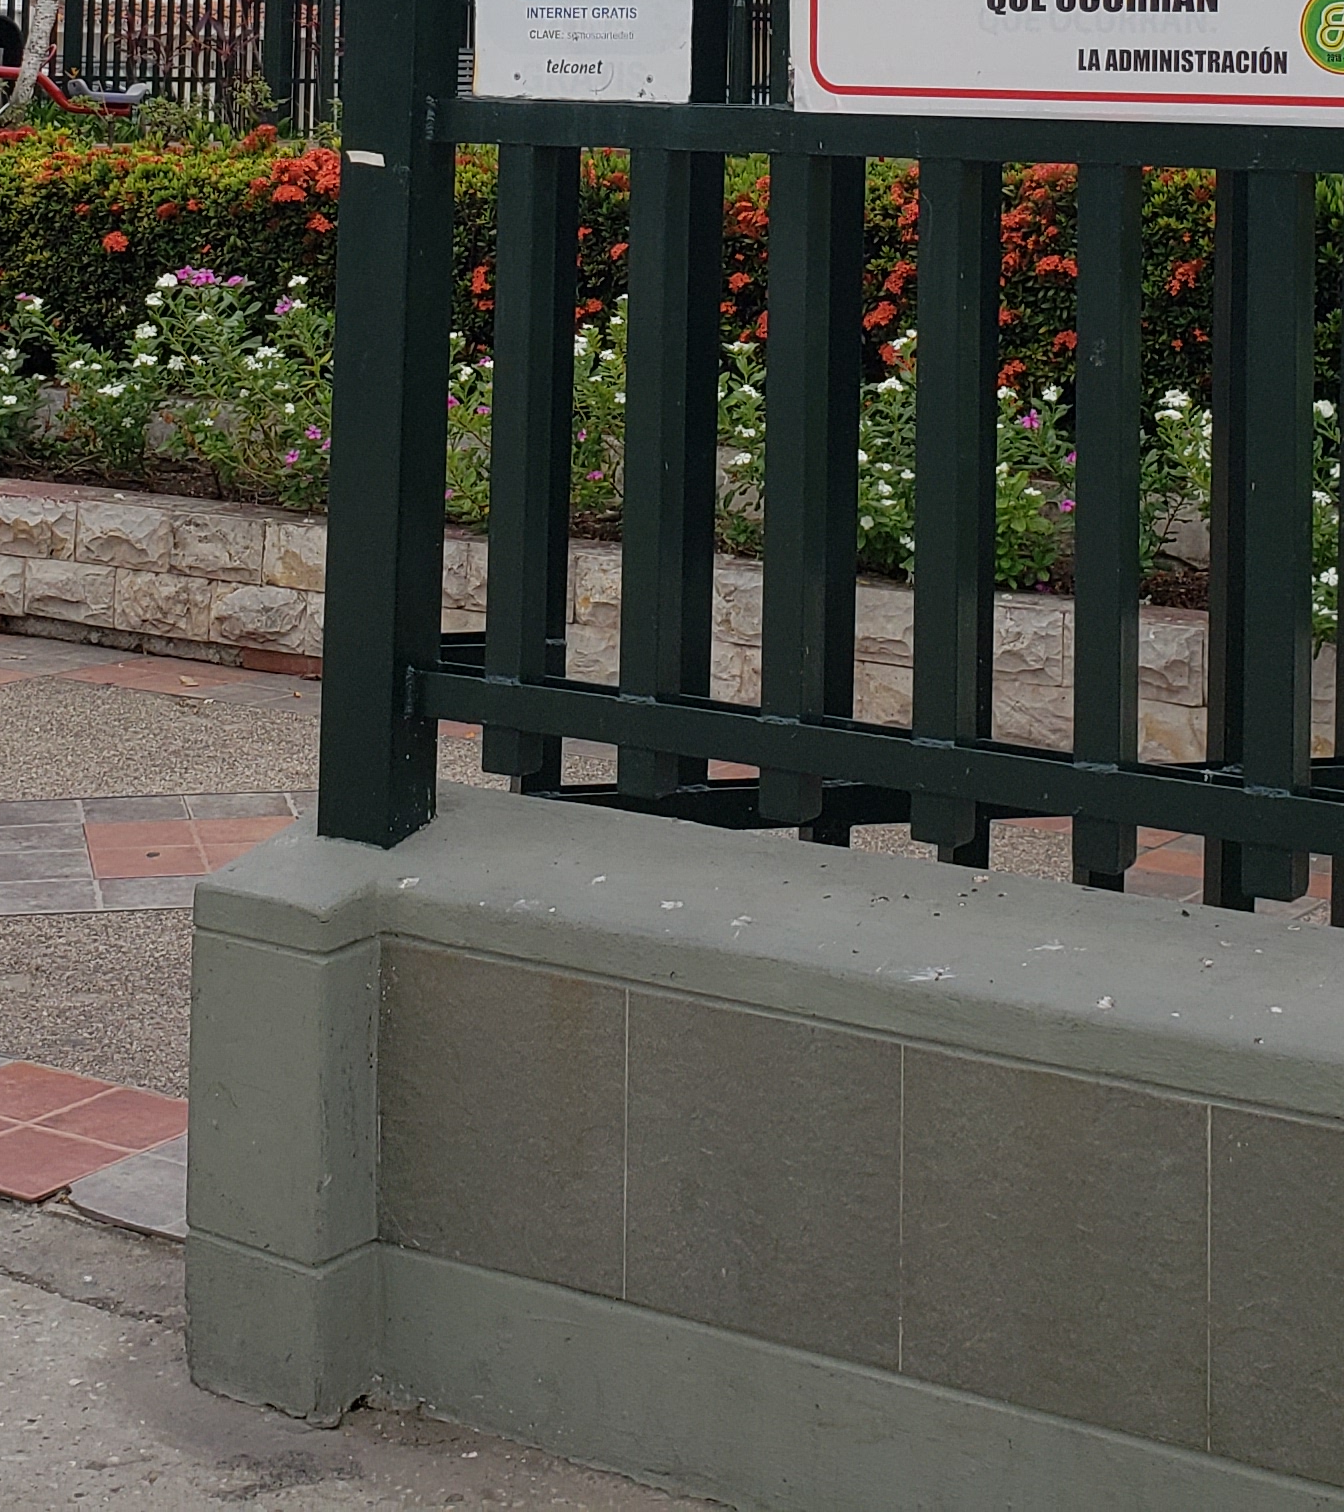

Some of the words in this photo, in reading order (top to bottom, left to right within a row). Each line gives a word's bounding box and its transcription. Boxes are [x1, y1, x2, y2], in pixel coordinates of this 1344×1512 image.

[526, 7, 588, 19] INTERNET
[591, 7, 637, 19] GRATIS
[546, 59, 603, 74] telconet
[1077, 49, 1100, 72] LA
[1104, 45, 1288, 75] ADMINISTRACIÓN
